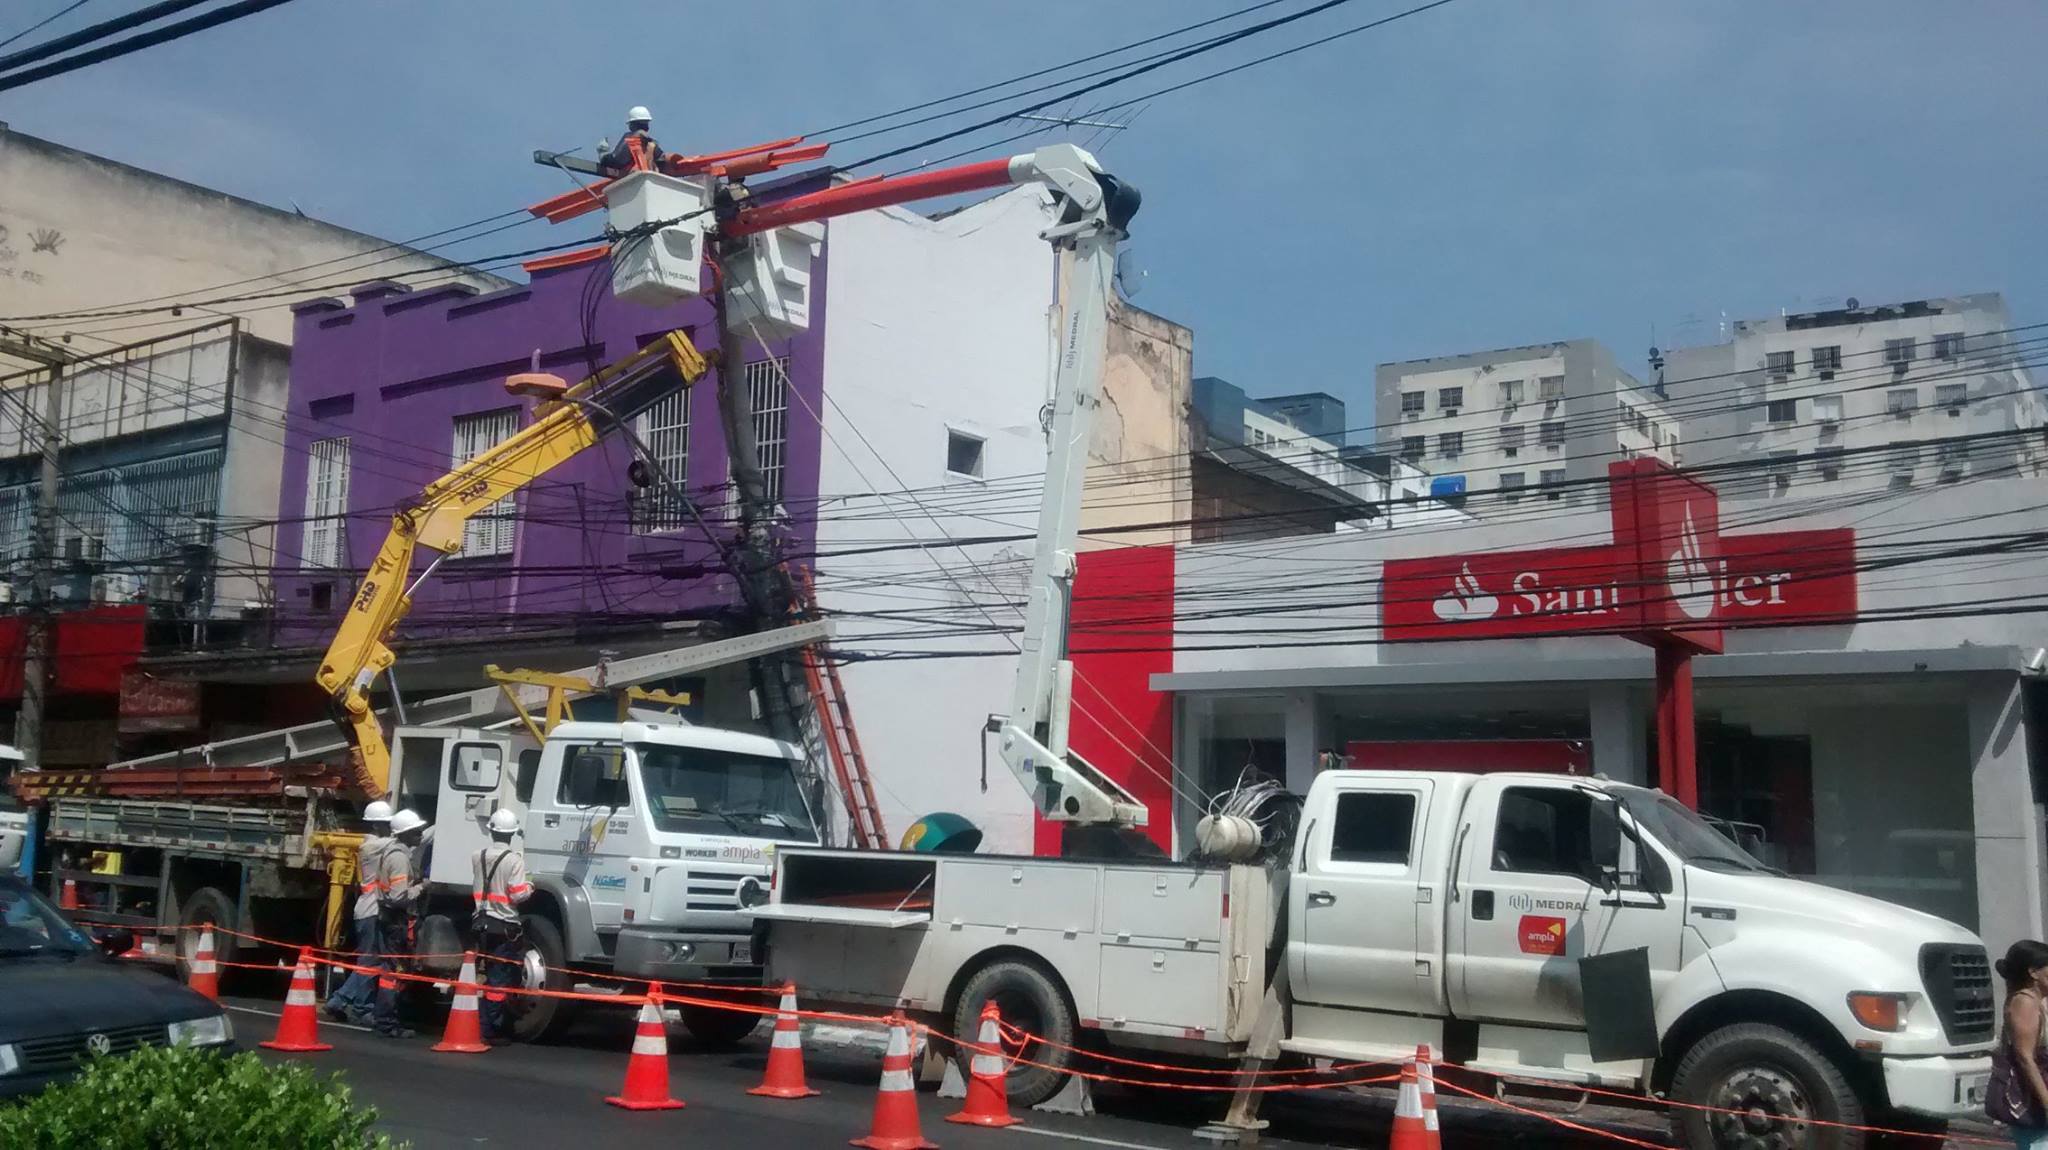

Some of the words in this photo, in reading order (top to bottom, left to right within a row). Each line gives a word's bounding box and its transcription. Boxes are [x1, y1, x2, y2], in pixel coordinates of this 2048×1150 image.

[685, 849, 717, 858] WORKER
[722, 844, 760, 863] ampla
[1536, 899, 1590, 911] MEDRAL
[1528, 932, 1555, 943] ampla
